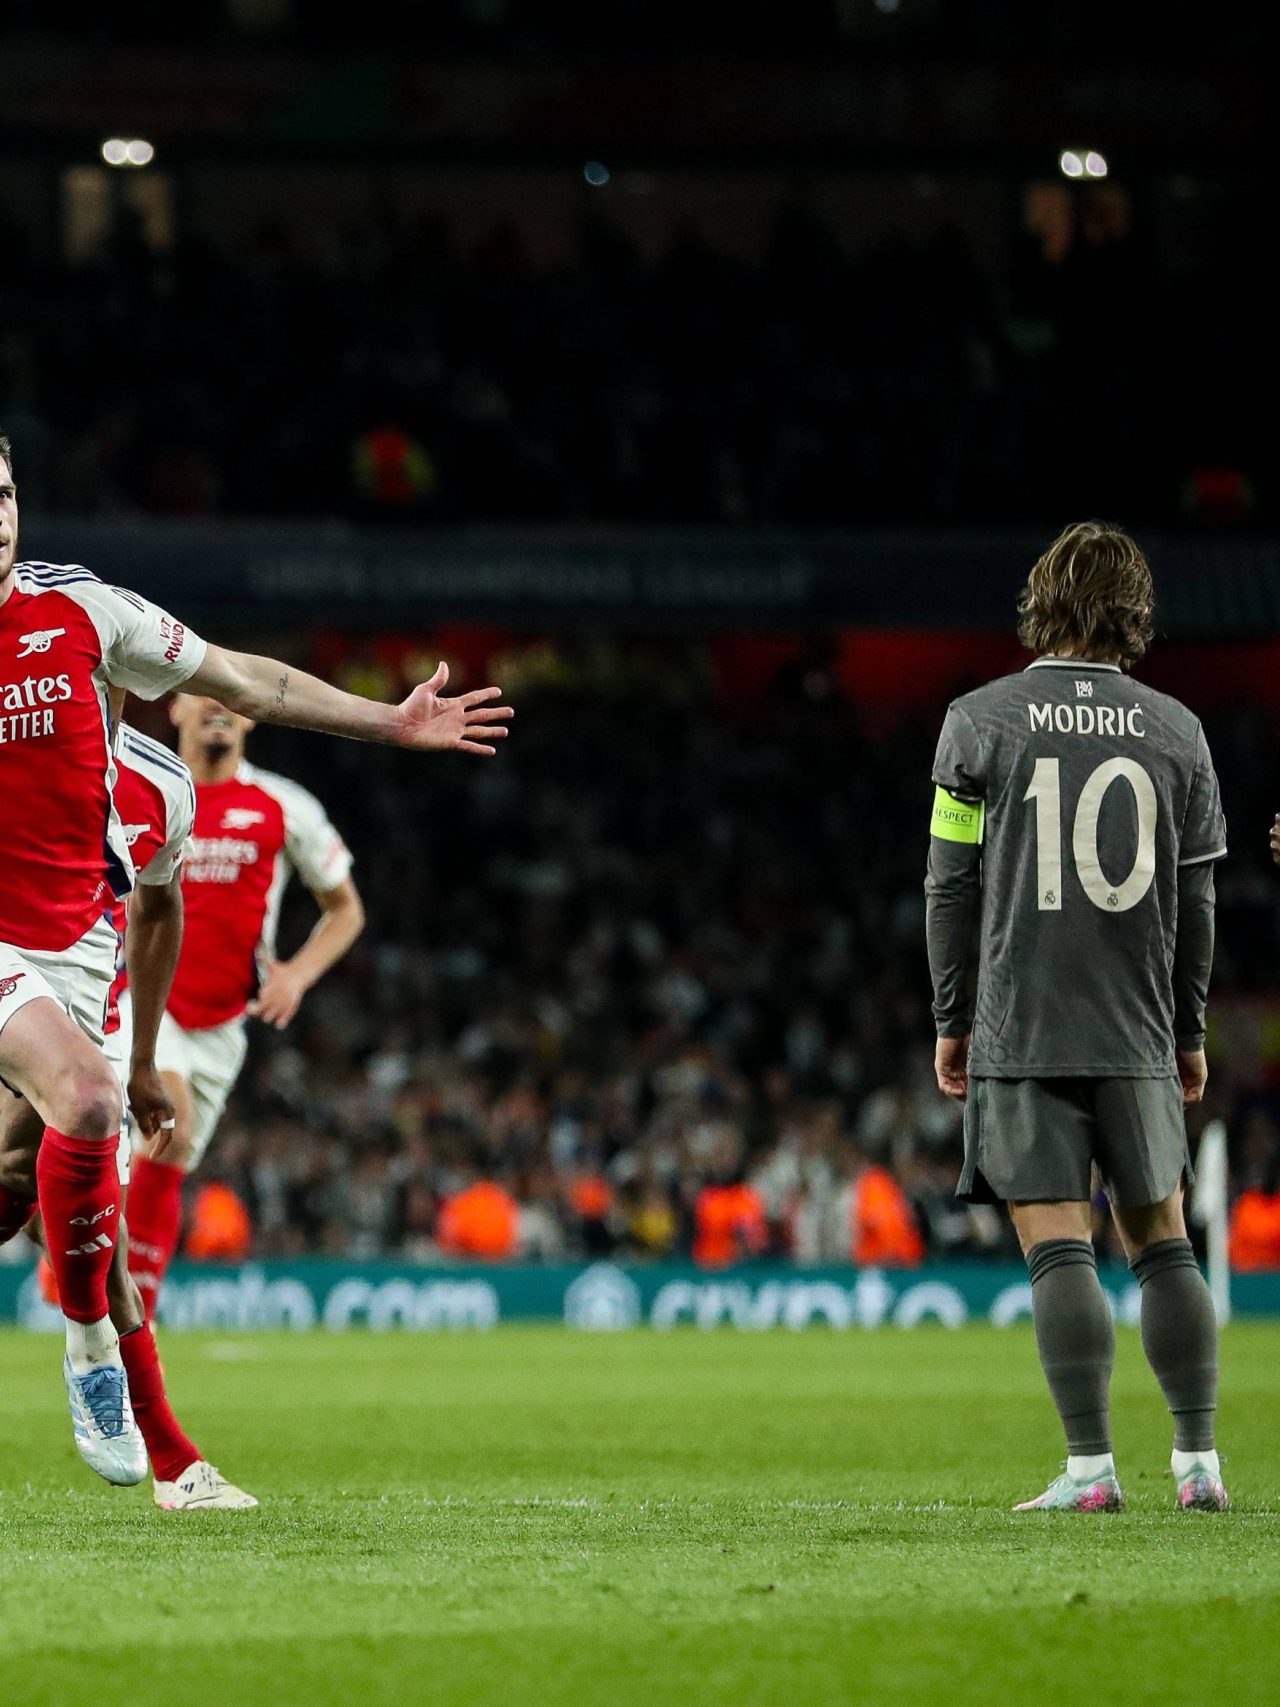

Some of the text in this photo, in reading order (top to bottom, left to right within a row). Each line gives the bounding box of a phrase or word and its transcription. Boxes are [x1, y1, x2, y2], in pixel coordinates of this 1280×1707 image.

[1027, 702, 1147, 738] MODRIĆ
[1022, 756, 1158, 913] 10
[69, 1203, 115, 1226] AFC
